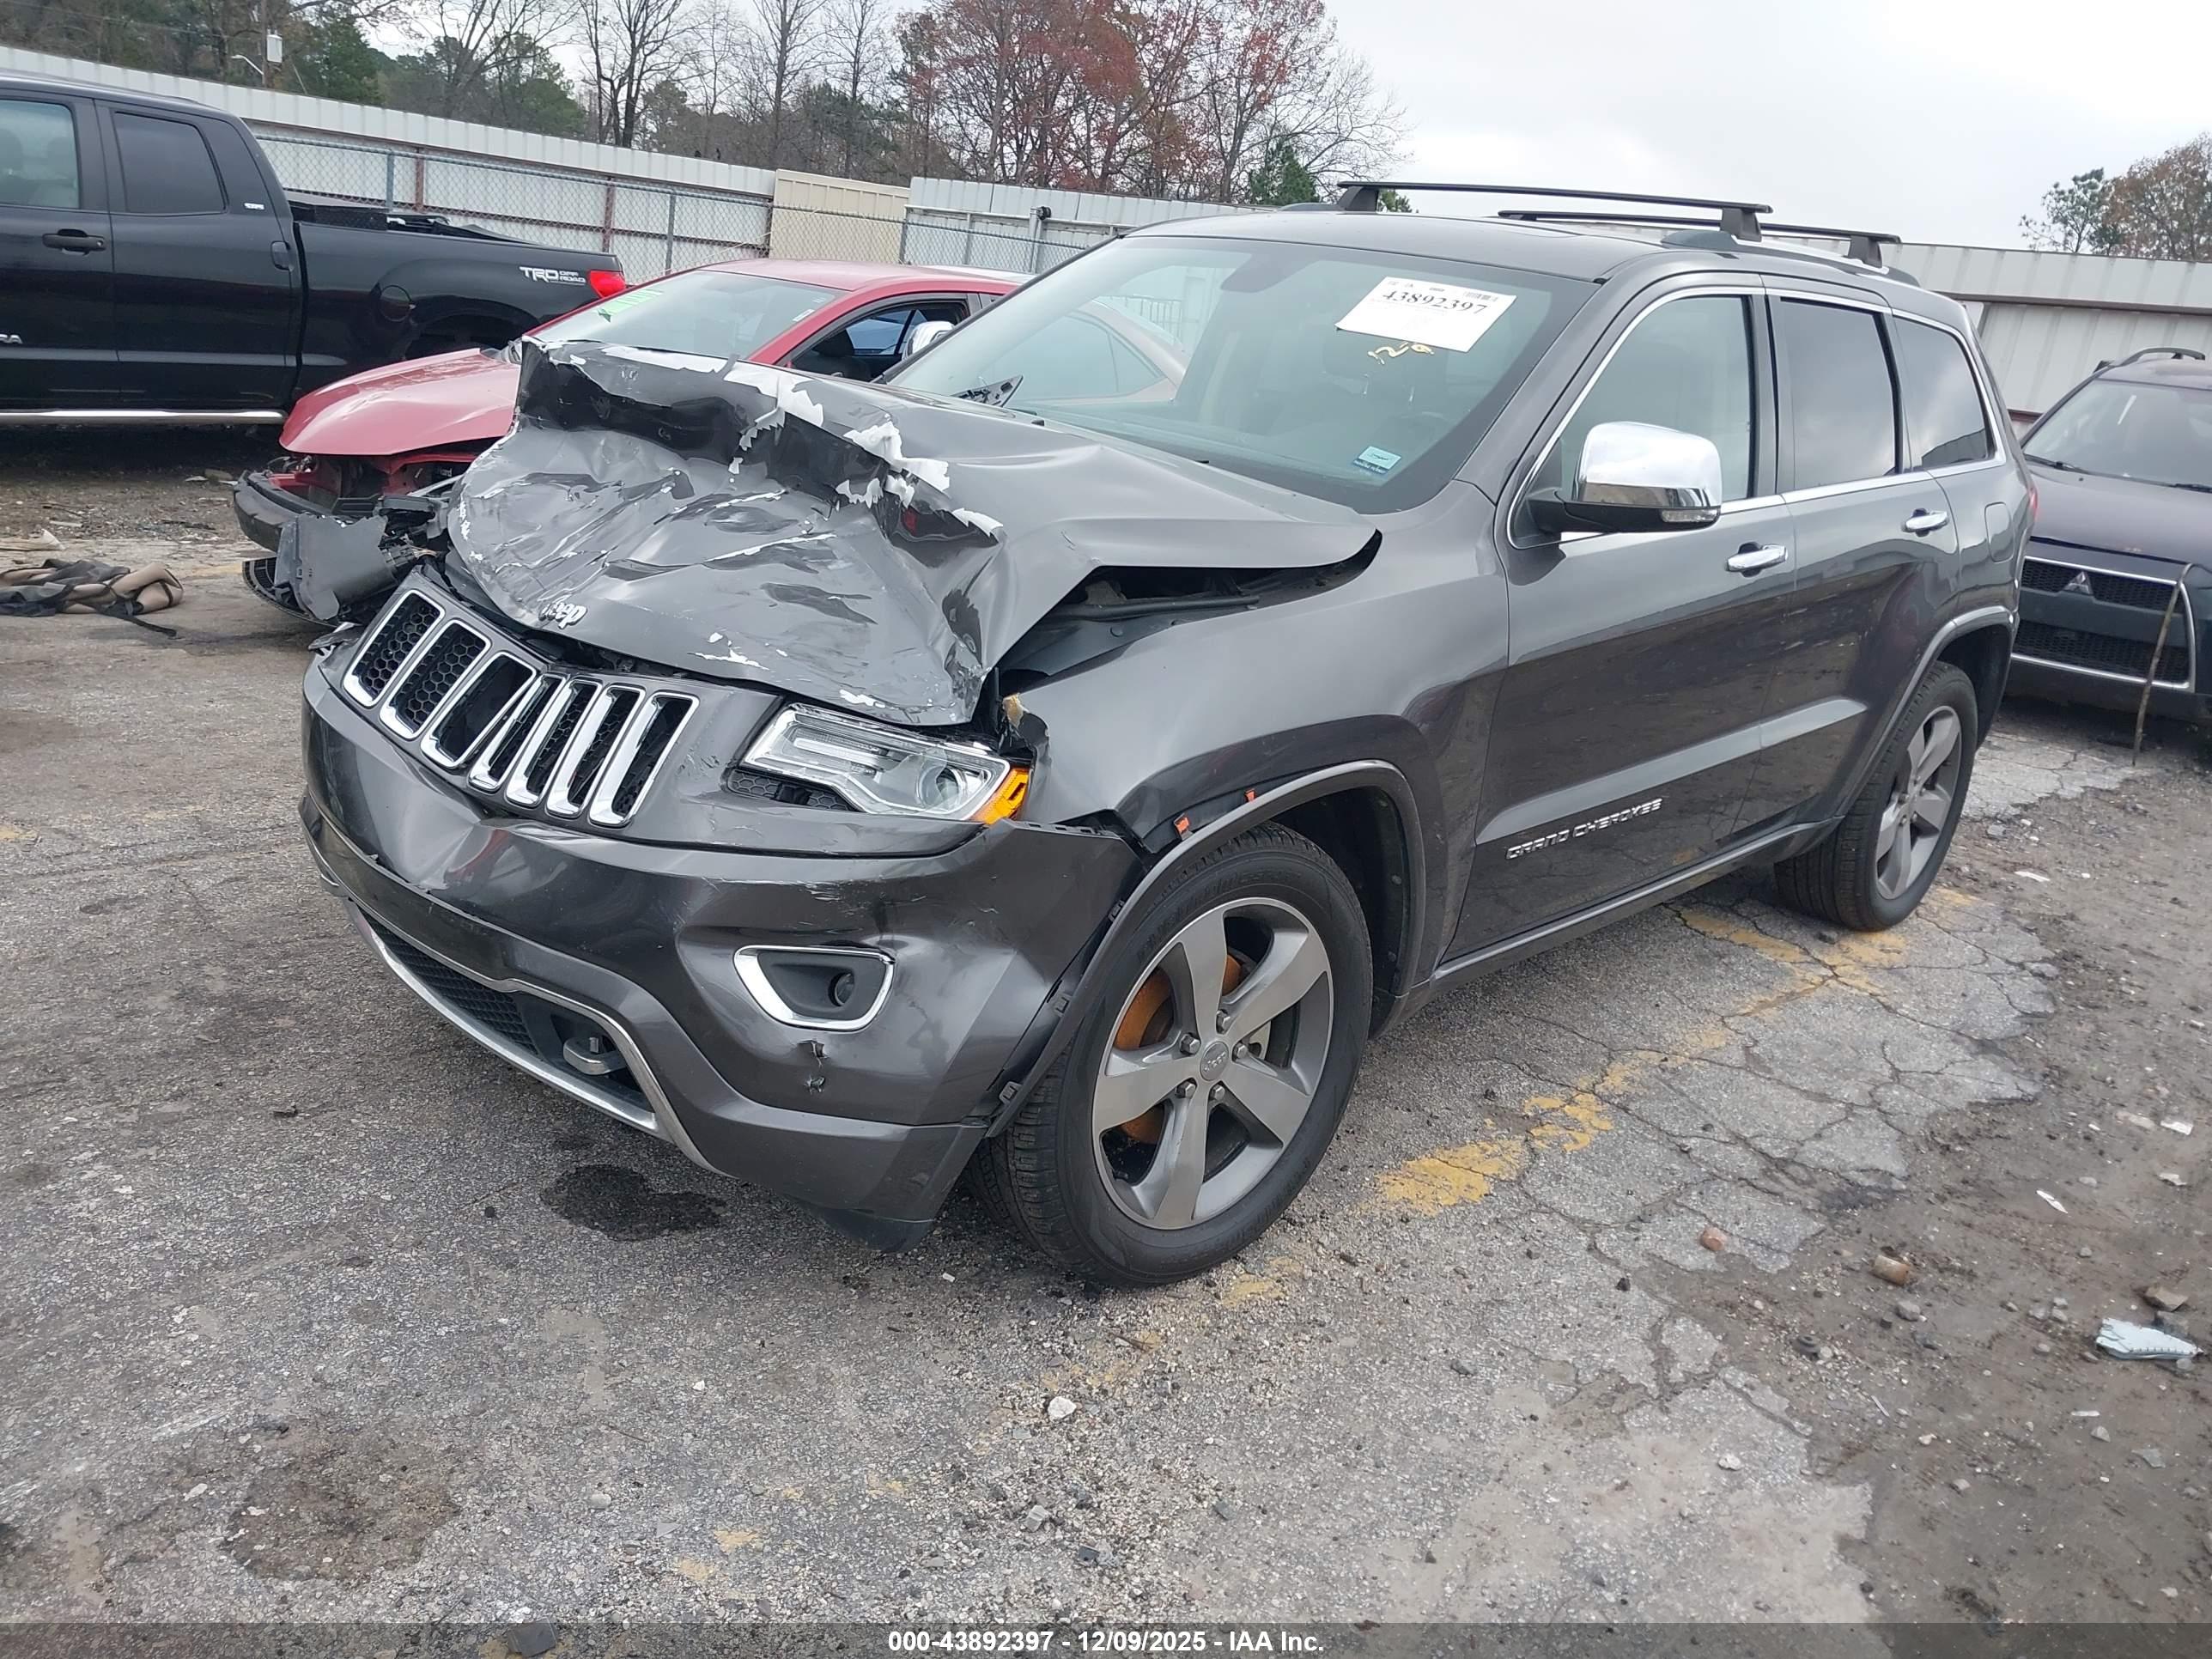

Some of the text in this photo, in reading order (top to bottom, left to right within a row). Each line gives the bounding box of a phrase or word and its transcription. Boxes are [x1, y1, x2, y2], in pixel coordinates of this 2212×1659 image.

[519, 266, 559, 283] TRD
[1382, 290, 1488, 314] 43892397
[540, 602, 587, 629] Jeep
[1506, 798, 1662, 859] GRAND CHEROKEE
